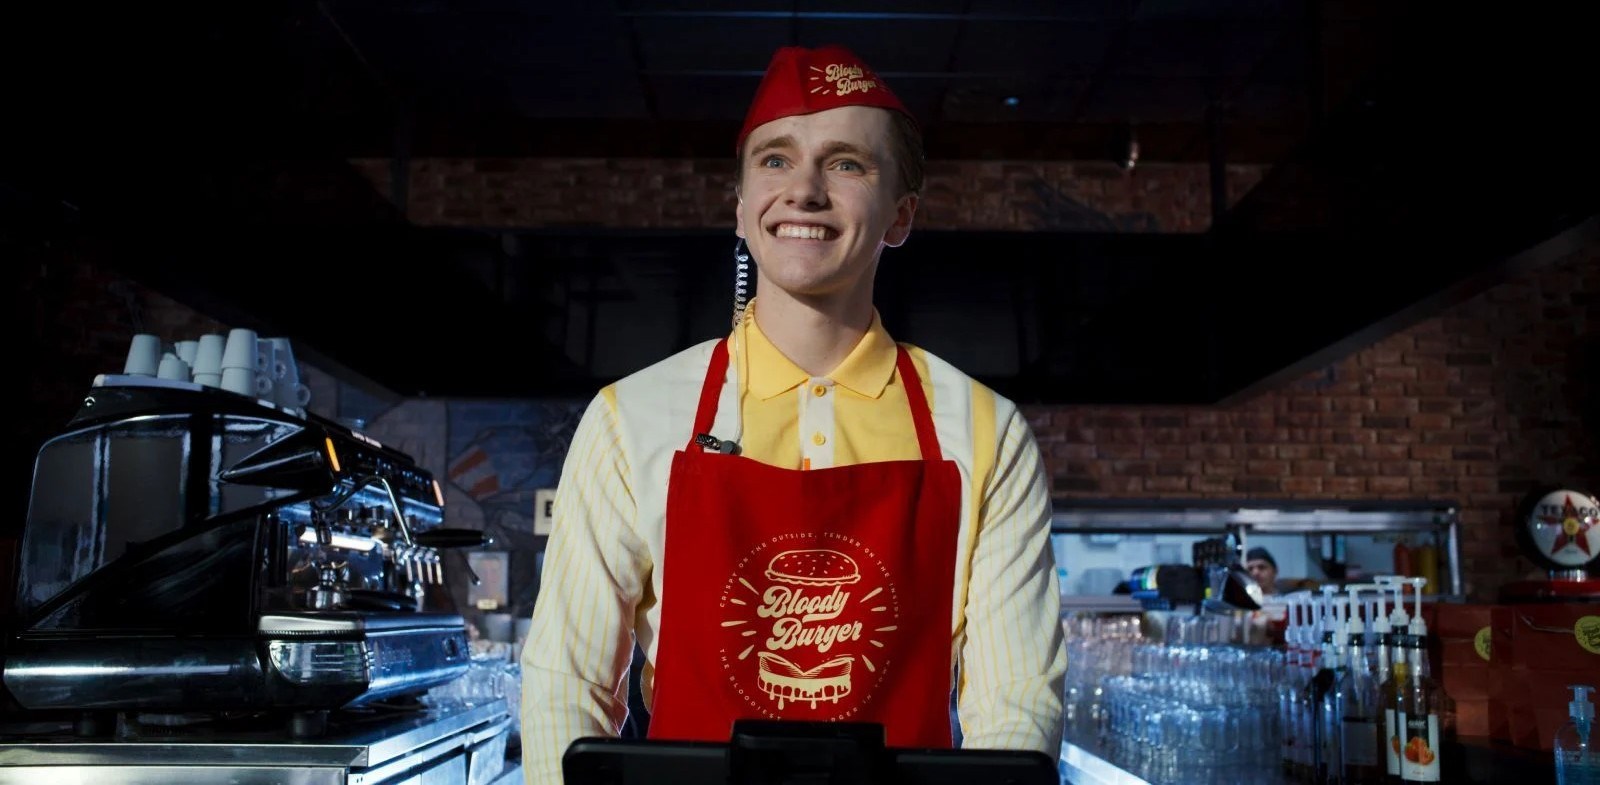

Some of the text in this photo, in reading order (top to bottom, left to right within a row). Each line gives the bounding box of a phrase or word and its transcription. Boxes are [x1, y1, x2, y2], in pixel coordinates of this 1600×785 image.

[825, 63, 863, 82] Bloody
[836, 78, 876, 97] Burger
[750, 542, 767, 555] THE
[824, 532, 861, 547] TENDER
[864, 548, 875, 558] ON
[876, 560, 890, 578] THE
[757, 584, 850, 623] Bloody
[766, 617, 863, 653] Burger
[719, 648, 730, 670] THE
